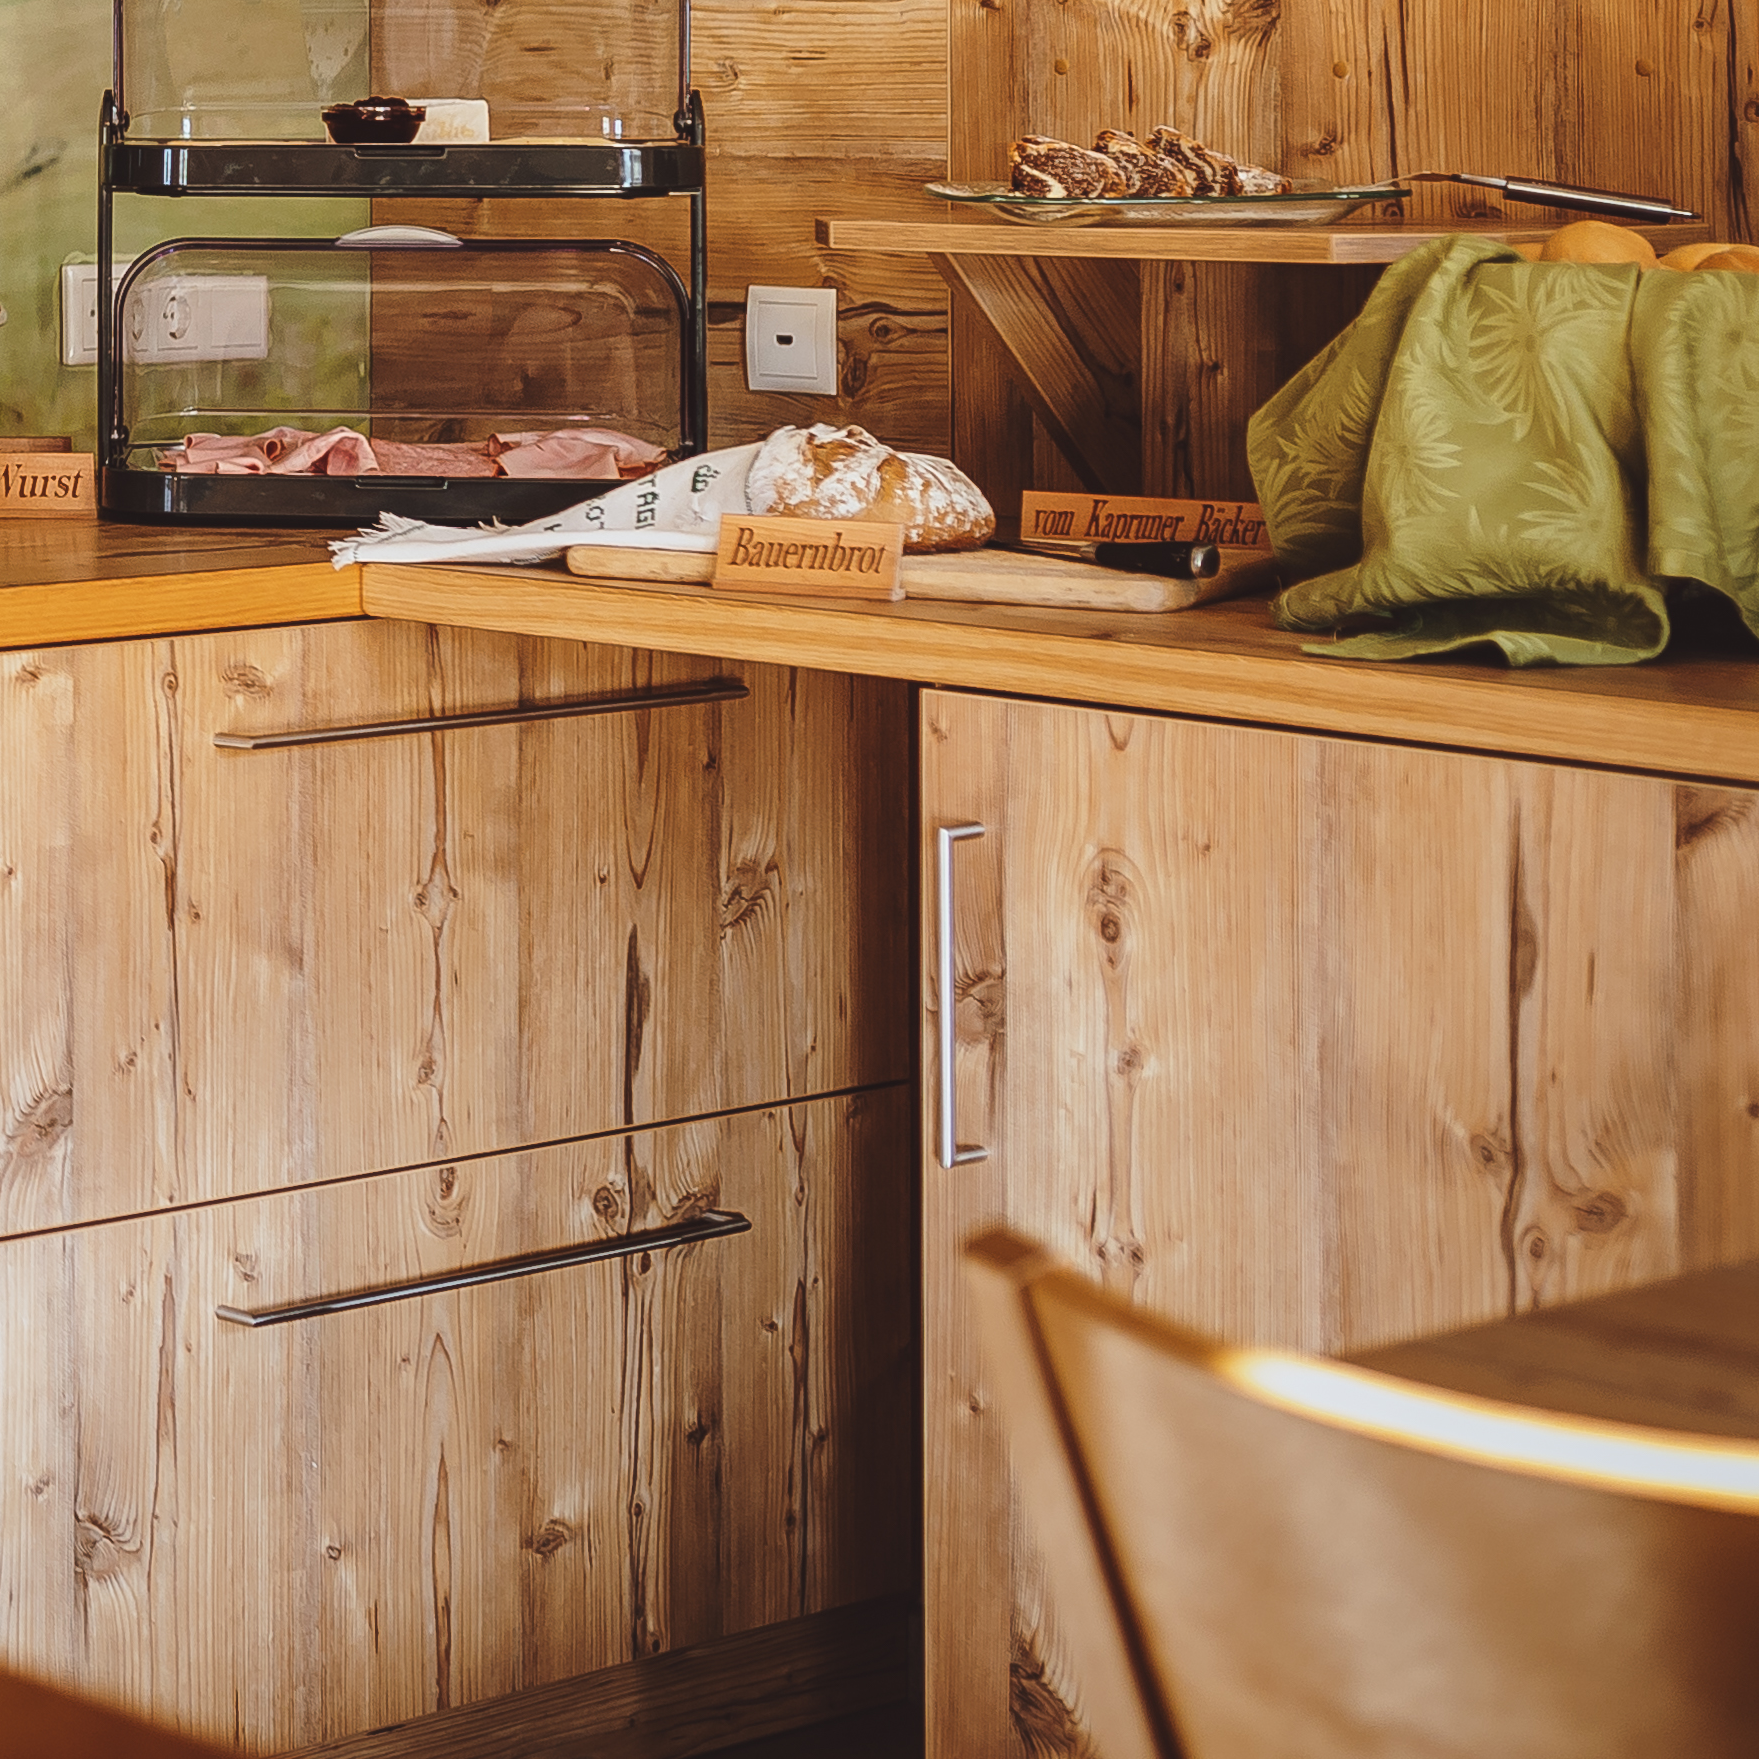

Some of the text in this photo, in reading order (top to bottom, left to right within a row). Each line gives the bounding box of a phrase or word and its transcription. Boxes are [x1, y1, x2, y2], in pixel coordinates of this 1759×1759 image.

[1033, 509, 1076, 537] vom
[1193, 503, 1267, 546] Bäcker
[727, 526, 887, 575] Bauernbrot
